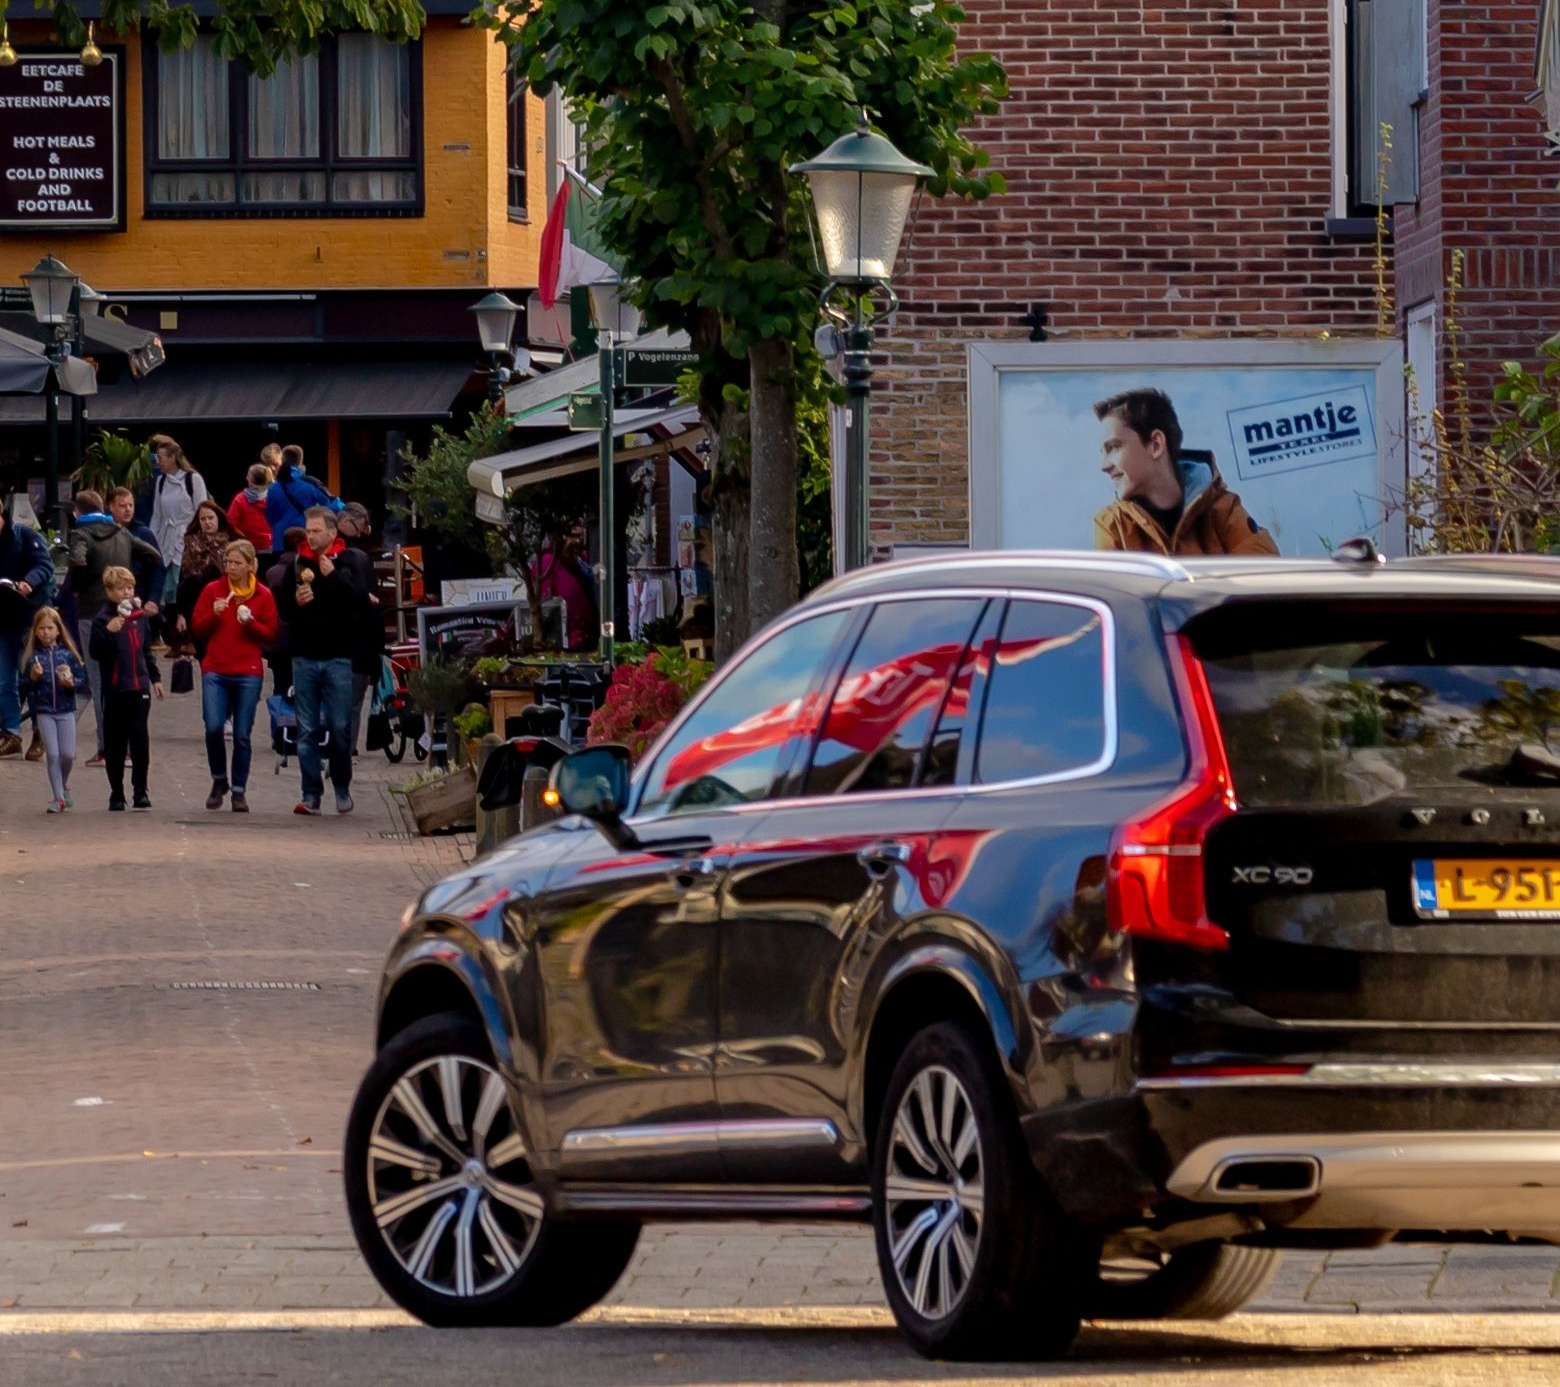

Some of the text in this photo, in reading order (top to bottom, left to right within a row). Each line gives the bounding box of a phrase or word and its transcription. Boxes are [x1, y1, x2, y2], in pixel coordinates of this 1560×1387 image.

[22, 64, 85, 77] EETCAFE
[43, 80, 64, 92] DE
[13, 136, 96, 148] HOT MEALS
[48, 152, 61, 165] &
[6, 168, 104, 180] COLD DRINKS
[37, 184, 72, 196] AND
[17, 200, 93, 212] FOOTBALL
[1243, 401, 1357, 444] mantje
[1418, 888, 1437, 902] NL
